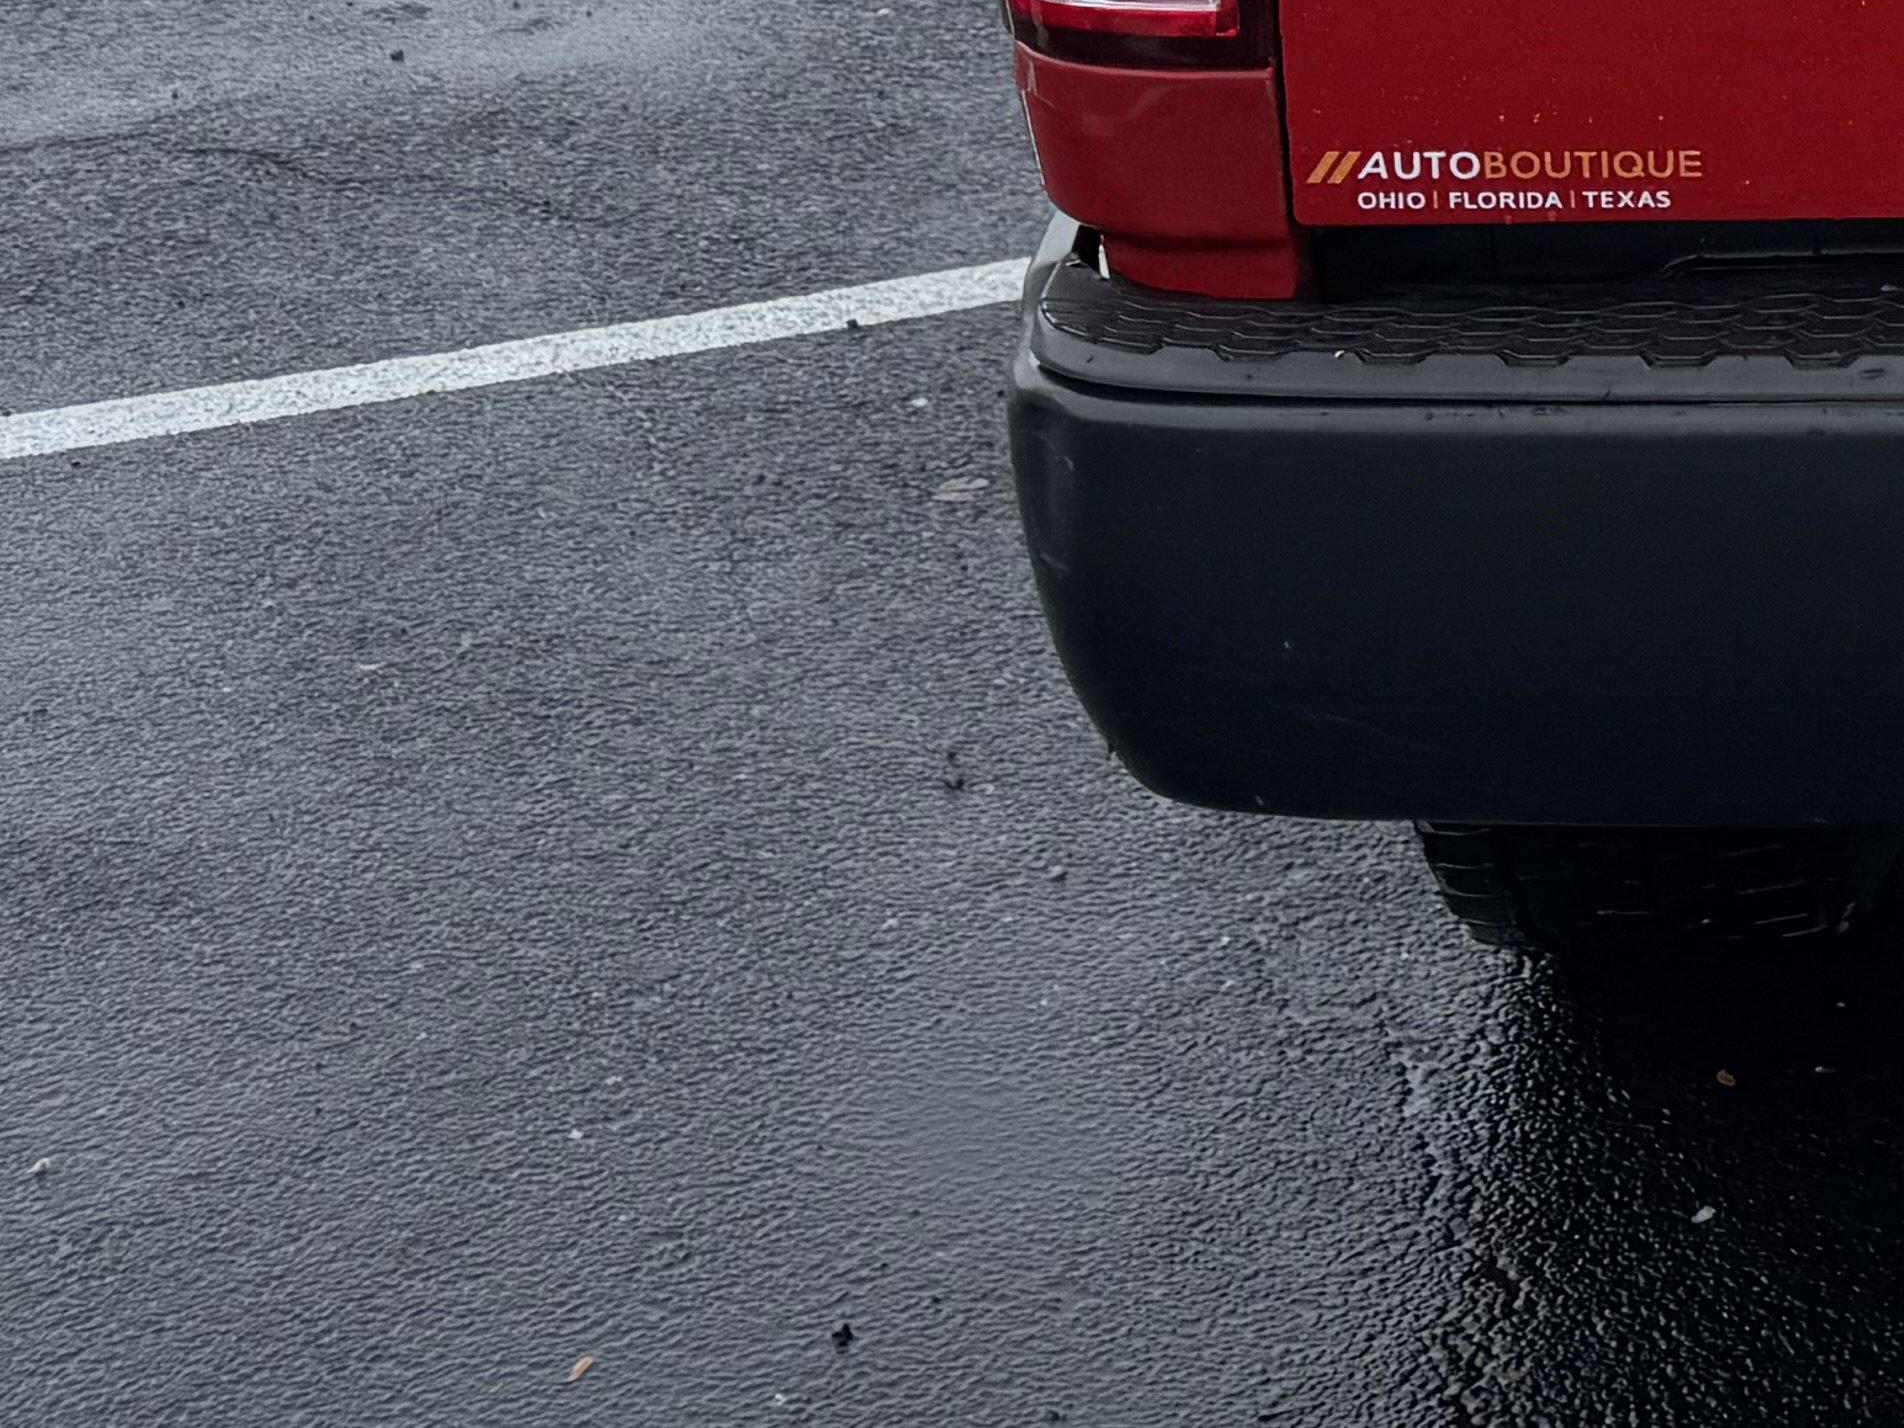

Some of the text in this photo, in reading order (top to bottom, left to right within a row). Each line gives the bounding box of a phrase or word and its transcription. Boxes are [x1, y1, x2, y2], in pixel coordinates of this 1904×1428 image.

[1357, 149, 1703, 180] AUTOBOUTIQUE
[1357, 189, 1671, 210] OHIO FLORIDA TEXAS
